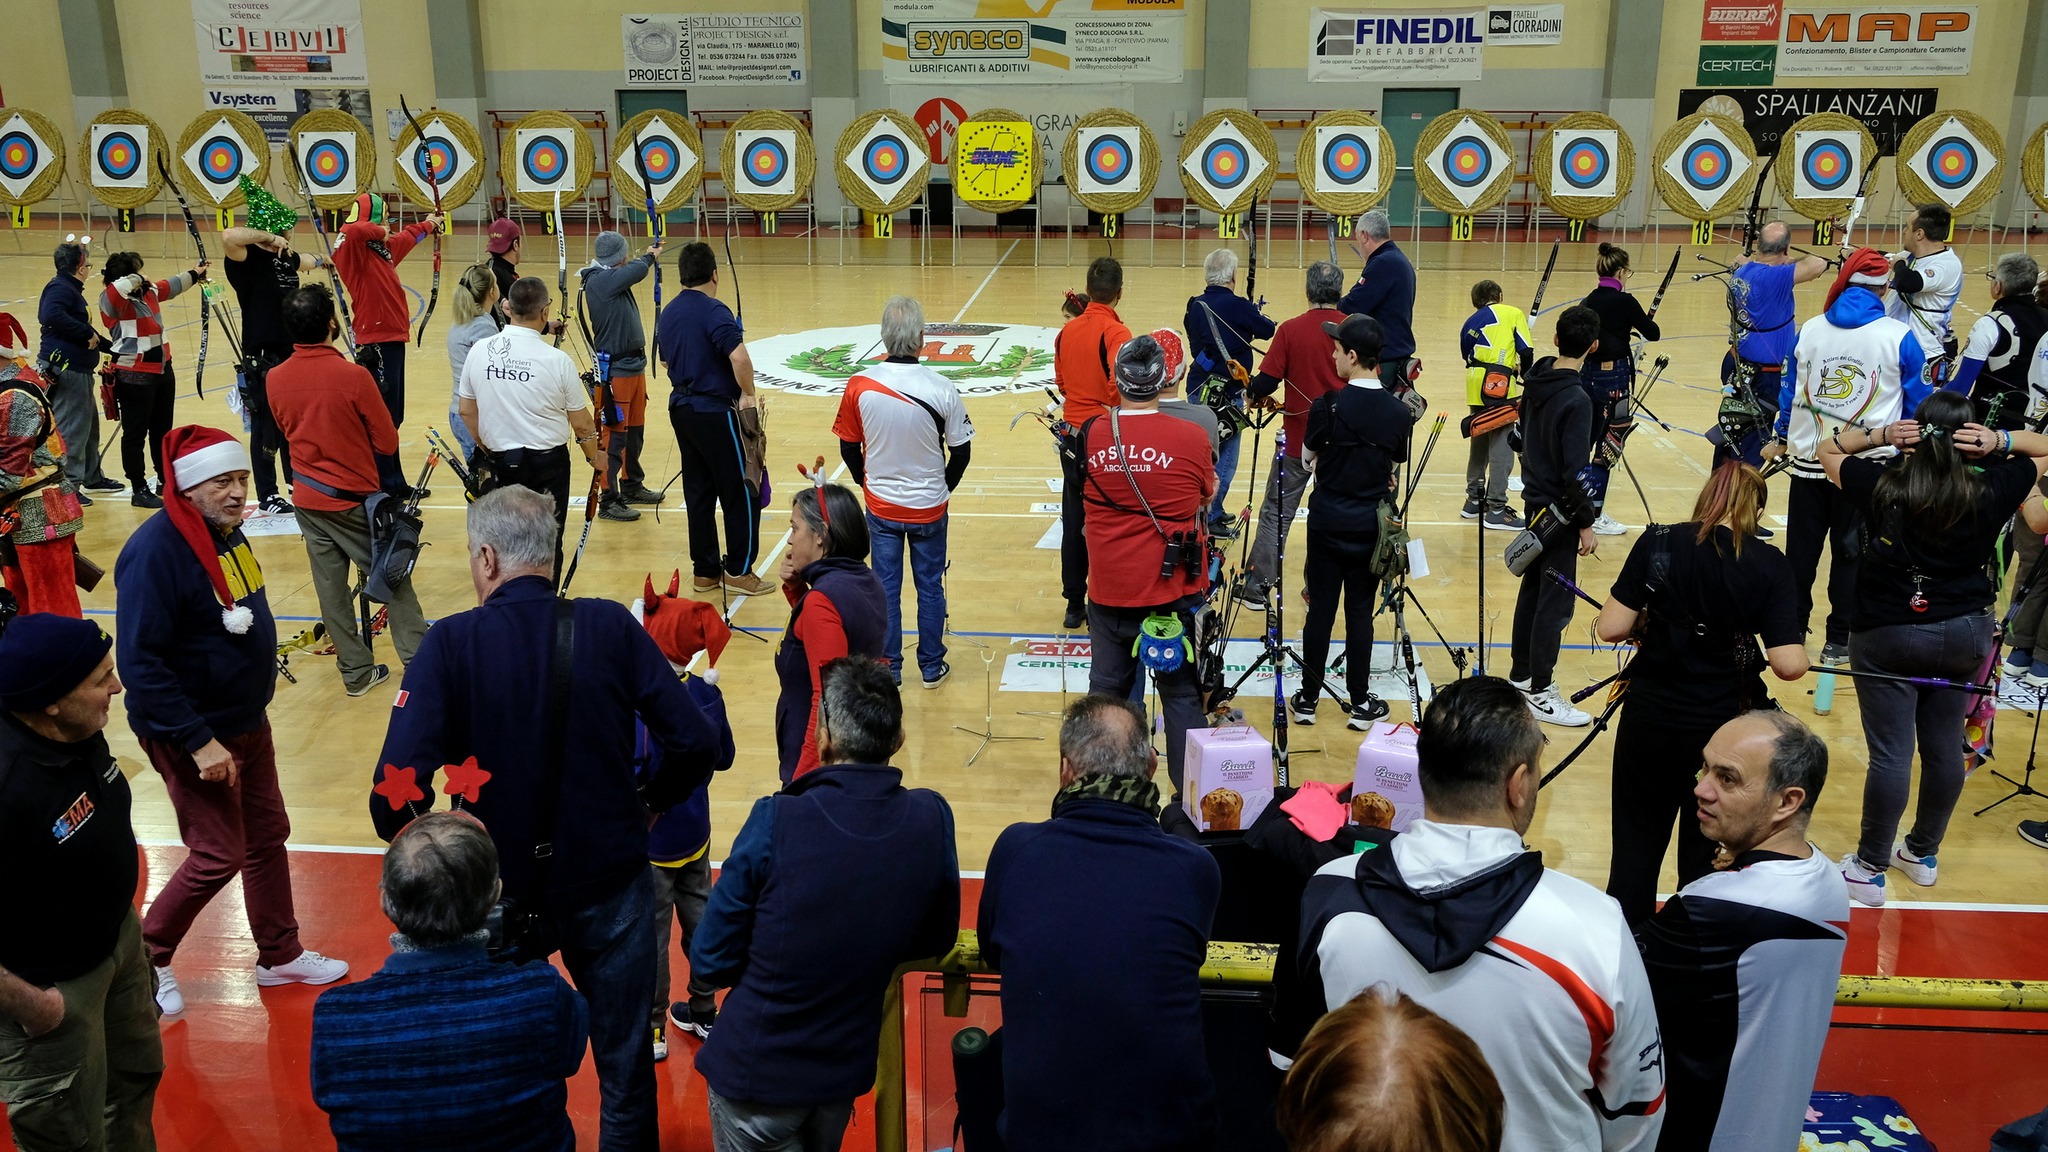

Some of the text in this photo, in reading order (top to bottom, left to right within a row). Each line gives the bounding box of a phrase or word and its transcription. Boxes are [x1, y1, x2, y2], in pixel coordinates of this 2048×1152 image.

[693, 16, 801, 26] STUDIO TECNICO
[1513, 19, 1561, 32] CORRADINI
[1708, 10, 1769, 21] BIERRE
[219, 27, 332, 47] CERVI
[693, 31, 733, 40] PROJECT
[1356, 18, 1483, 44] FINEDIL
[1786, 12, 1970, 42] MAP
[914, 30, 1023, 56] syneco
[1355, 47, 1483, 56] PREFABBRICATI
[1785, 47, 1847, 55] Confezionamento,
[1879, 47, 1927, 55] Campionature
[680, 40, 692, 80] DESIGN
[909, 64, 1030, 73] LUBRIFICANTI & ADDITIVI
[1702, 60, 1772, 71] CERTECH
[629, 69, 679, 81] PROJECT
[17, 206, 24, 226] 4
[123, 209, 130, 232] 5
[546, 212, 554, 234] 9
[763, 212, 775, 234] 11
[875, 214, 889, 238] 12
[1103, 214, 1116, 238] 13
[1222, 214, 1236, 237] 14
[1337, 215, 1351, 237] 15
[1455, 215, 1469, 239] 16
[1570, 219, 1584, 241] 17
[1694, 220, 1710, 245] 18
[1815, 220, 1830, 245] 19
[506, 358, 531, 367] Arcieri
[486, 365, 530, 382] fuso
[1129, 464, 1151, 472] CLUB
[1221, 760, 1256, 771] Bauli
[1374, 765, 1412, 782] Bauli
